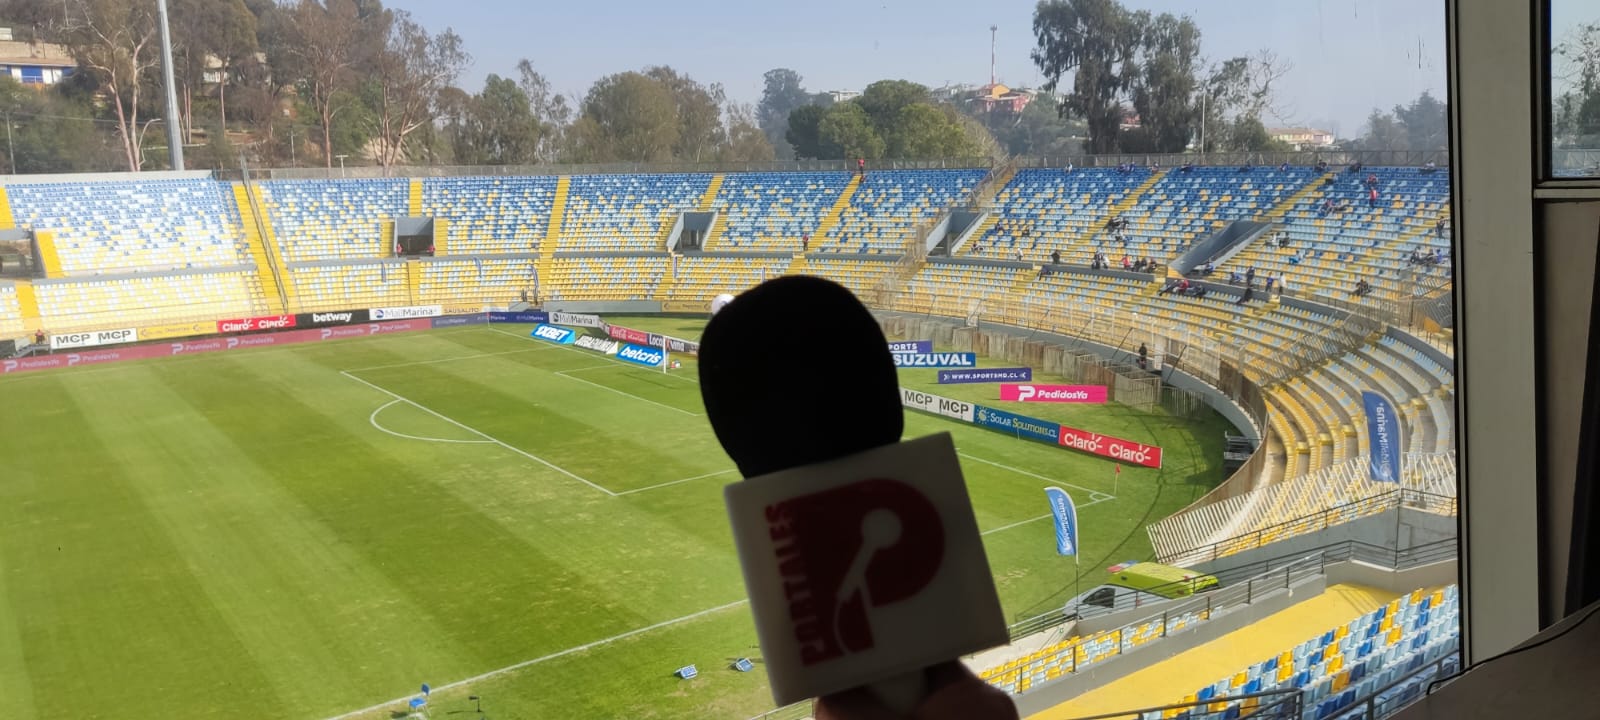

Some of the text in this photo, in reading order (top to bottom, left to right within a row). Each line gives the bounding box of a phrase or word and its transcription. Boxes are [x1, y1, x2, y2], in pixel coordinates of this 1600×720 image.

[222, 320, 253, 332] Claro
[258, 316, 289, 328] Claro
[312, 312, 352, 323] betway
[55, 329, 132, 345] MCP MCP
[620, 345, 662, 364] betcris
[888, 342, 918, 351] PORTS
[893, 353, 972, 366] SUZUVAL
[951, 371, 1018, 380] WWW.SPORTSMD.CL
[904, 390, 969, 415] MCP MCP
[1038, 389, 1088, 400] PedidosYa
[1064, 433, 1151, 463] Claro Claro
[764, 502, 827, 666] PORTALES
